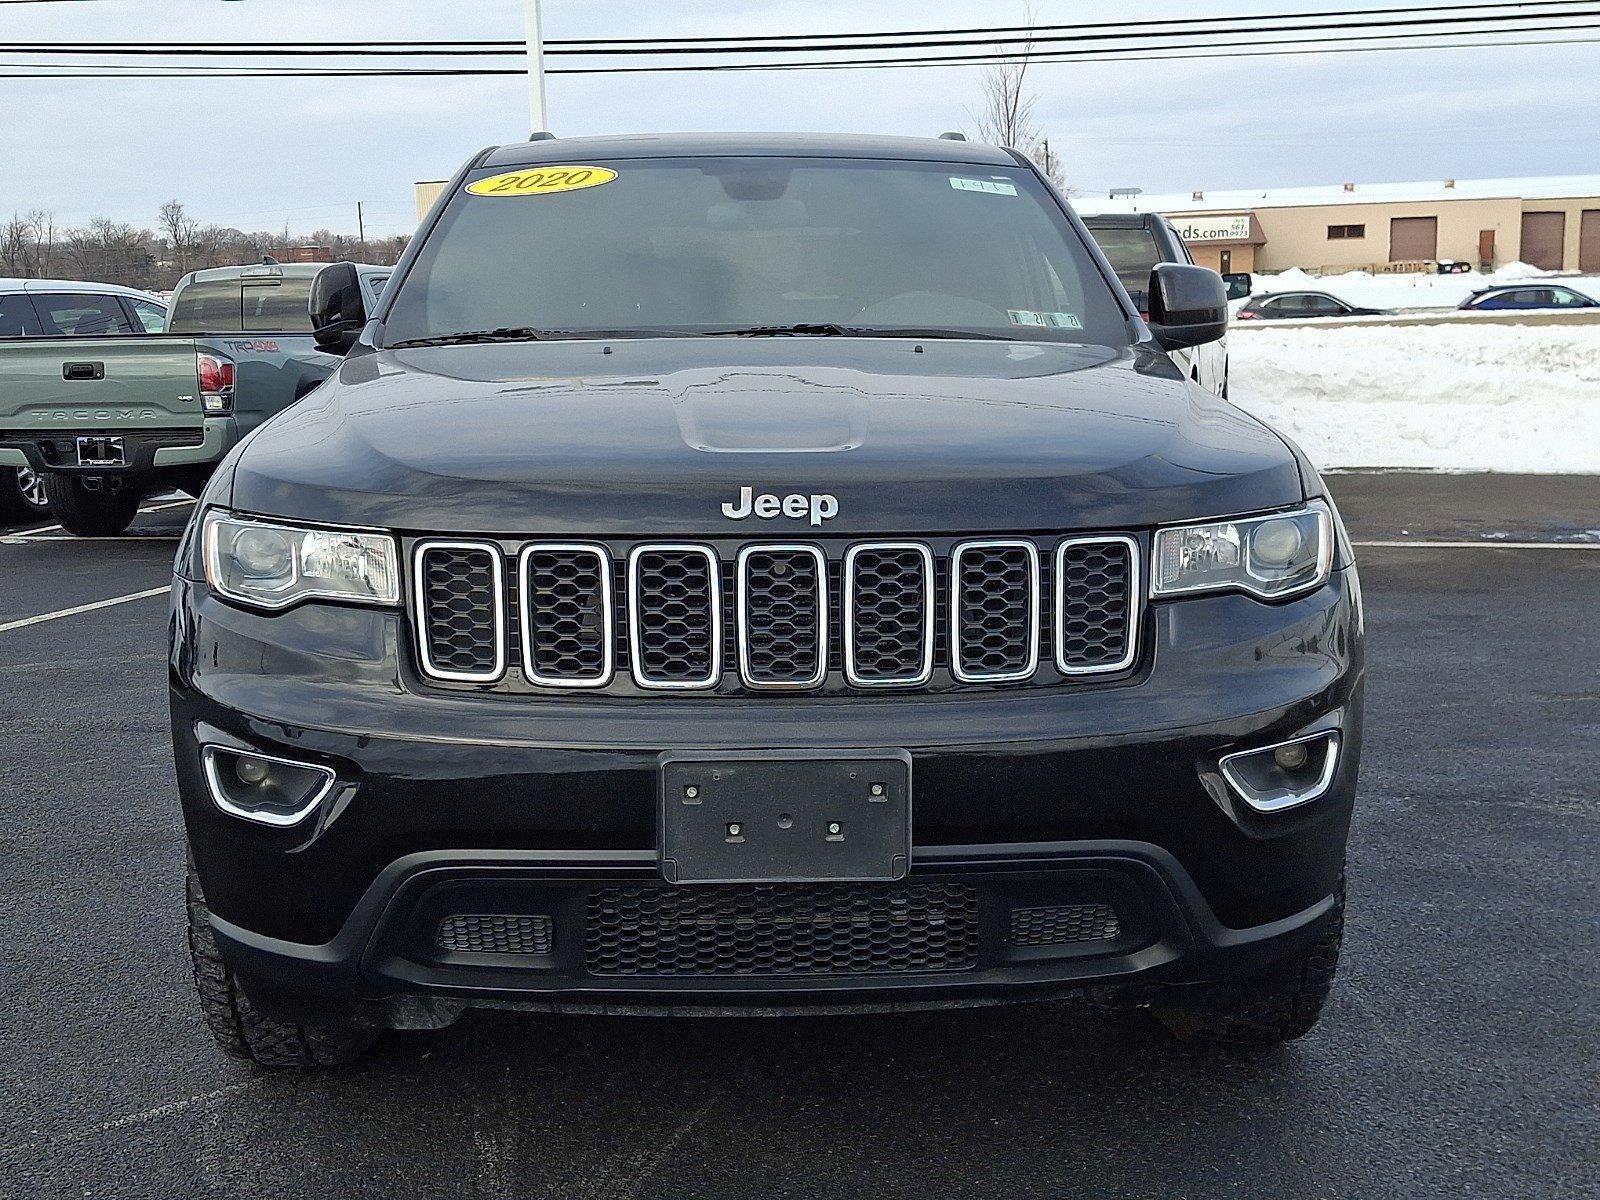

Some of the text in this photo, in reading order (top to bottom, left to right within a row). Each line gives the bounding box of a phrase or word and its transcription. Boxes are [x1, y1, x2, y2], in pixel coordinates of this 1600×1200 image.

[489, 170, 593, 193] 2020
[1178, 225, 1229, 239] ds.com
[31, 410, 158, 420] TACOMA
[721, 486, 839, 527] Jeep
